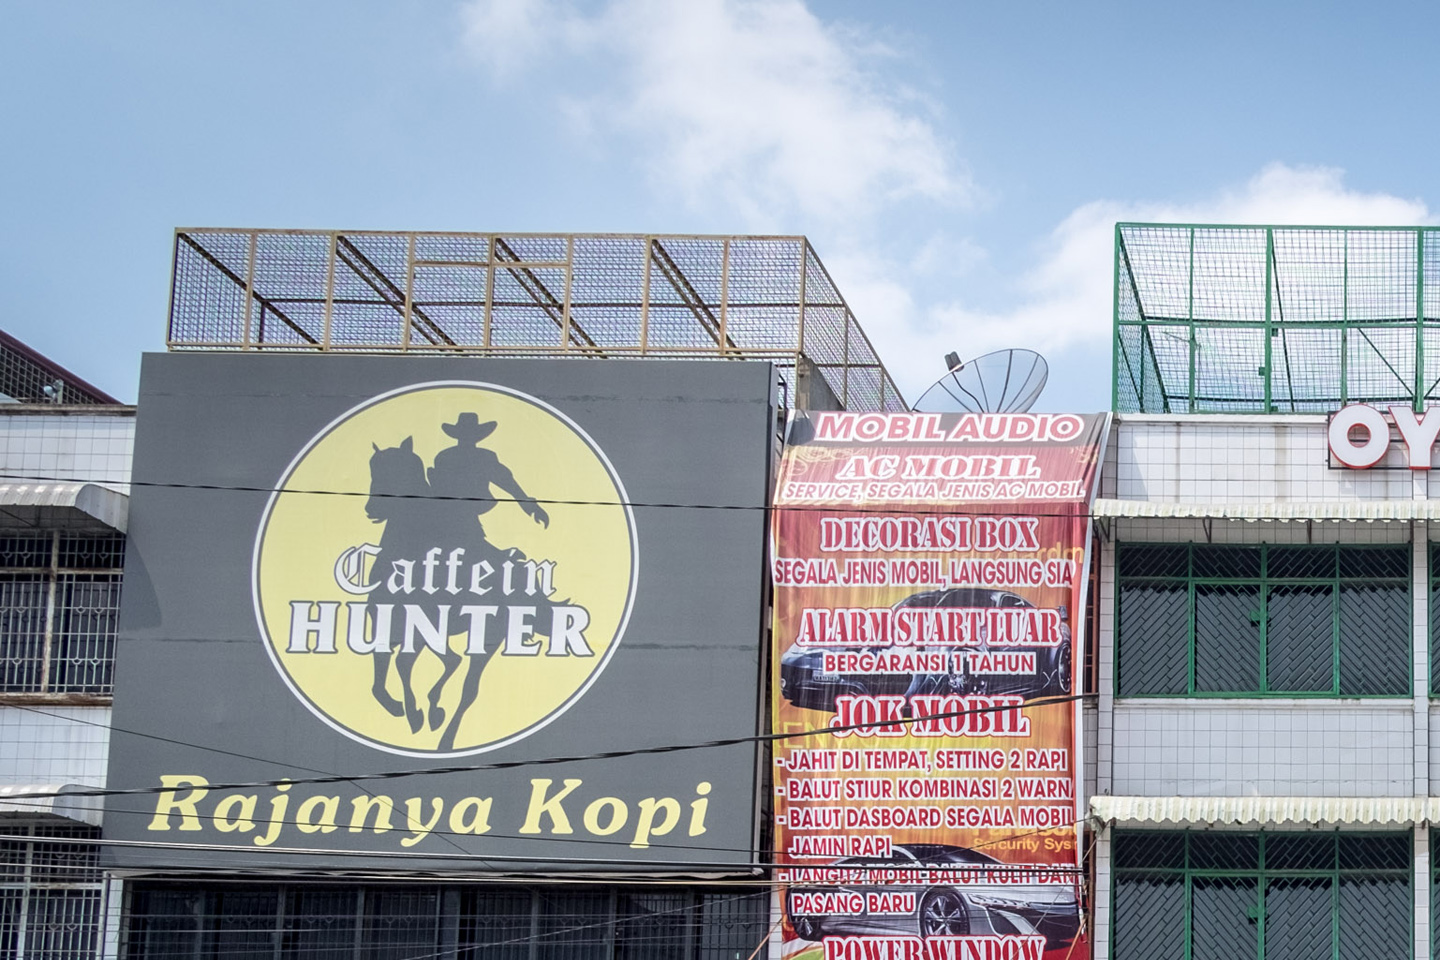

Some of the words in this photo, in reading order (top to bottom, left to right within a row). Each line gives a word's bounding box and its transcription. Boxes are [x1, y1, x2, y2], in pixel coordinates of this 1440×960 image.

[815, 413, 946, 442] MOBIL
[951, 413, 1085, 442] AUDIO
[836, 455, 899, 480] AC
[901, 455, 1041, 479] MOBIL
[784, 482, 863, 500] SERVICE,
[867, 481, 938, 499] SEGALA
[942, 481, 993, 499] JENIS
[992, 481, 1025, 498] AC
[1027, 479, 1086, 498] MOBIL
[820, 517, 972, 552] DECORASI
[974, 517, 1040, 552] BOX
[334, 542, 557, 596] Caffein
[774, 558, 837, 586] SEGALA
[842, 558, 887, 586] JENIS
[891, 558, 948, 591] MOBIL,
[950, 558, 1045, 586] LANGSUNG
[285, 600, 596, 658] HUNTER
[797, 607, 893, 646] ALARM
[893, 607, 983, 646] START
[985, 607, 1063, 647] LUAR
[823, 652, 949, 674] BERGARANSI
[950, 652, 966, 673] 1
[967, 652, 1037, 675] TAHUN
[830, 695, 907, 737] JOK
[908, 695, 1031, 737] MOBIL
[787, 749, 839, 771] JAHIT
[841, 749, 861, 771] DI
[863, 749, 934, 774] TEMPAT,
[935, 749, 1008, 771] SETTING
[1009, 749, 1024, 771] 2
[1025, 749, 1068, 771] RAPI
[788, 778, 842, 800] BALUT
[845, 778, 894, 800] STIUR
[898, 778, 998, 800] KOMBINASI
[1000, 778, 1014, 800] 2
[147, 774, 493, 848] Rajanya
[519, 778, 713, 849] Kopi
[788, 807, 842, 829] BALUT
[846, 807, 943, 829] DASBOARD
[945, 807, 1017, 829] SEGALA
[1018, 806, 1075, 828] MOBIL
[787, 835, 848, 858] JAMIN
[848, 835, 893, 858] RAPI
[973, 838, 1040, 853] Sercurity
[867, 863, 924, 885] MOBIL
[927, 863, 982, 885] BALUT
[791, 892, 865, 916] PASANG
[867, 892, 916, 915] BARU
